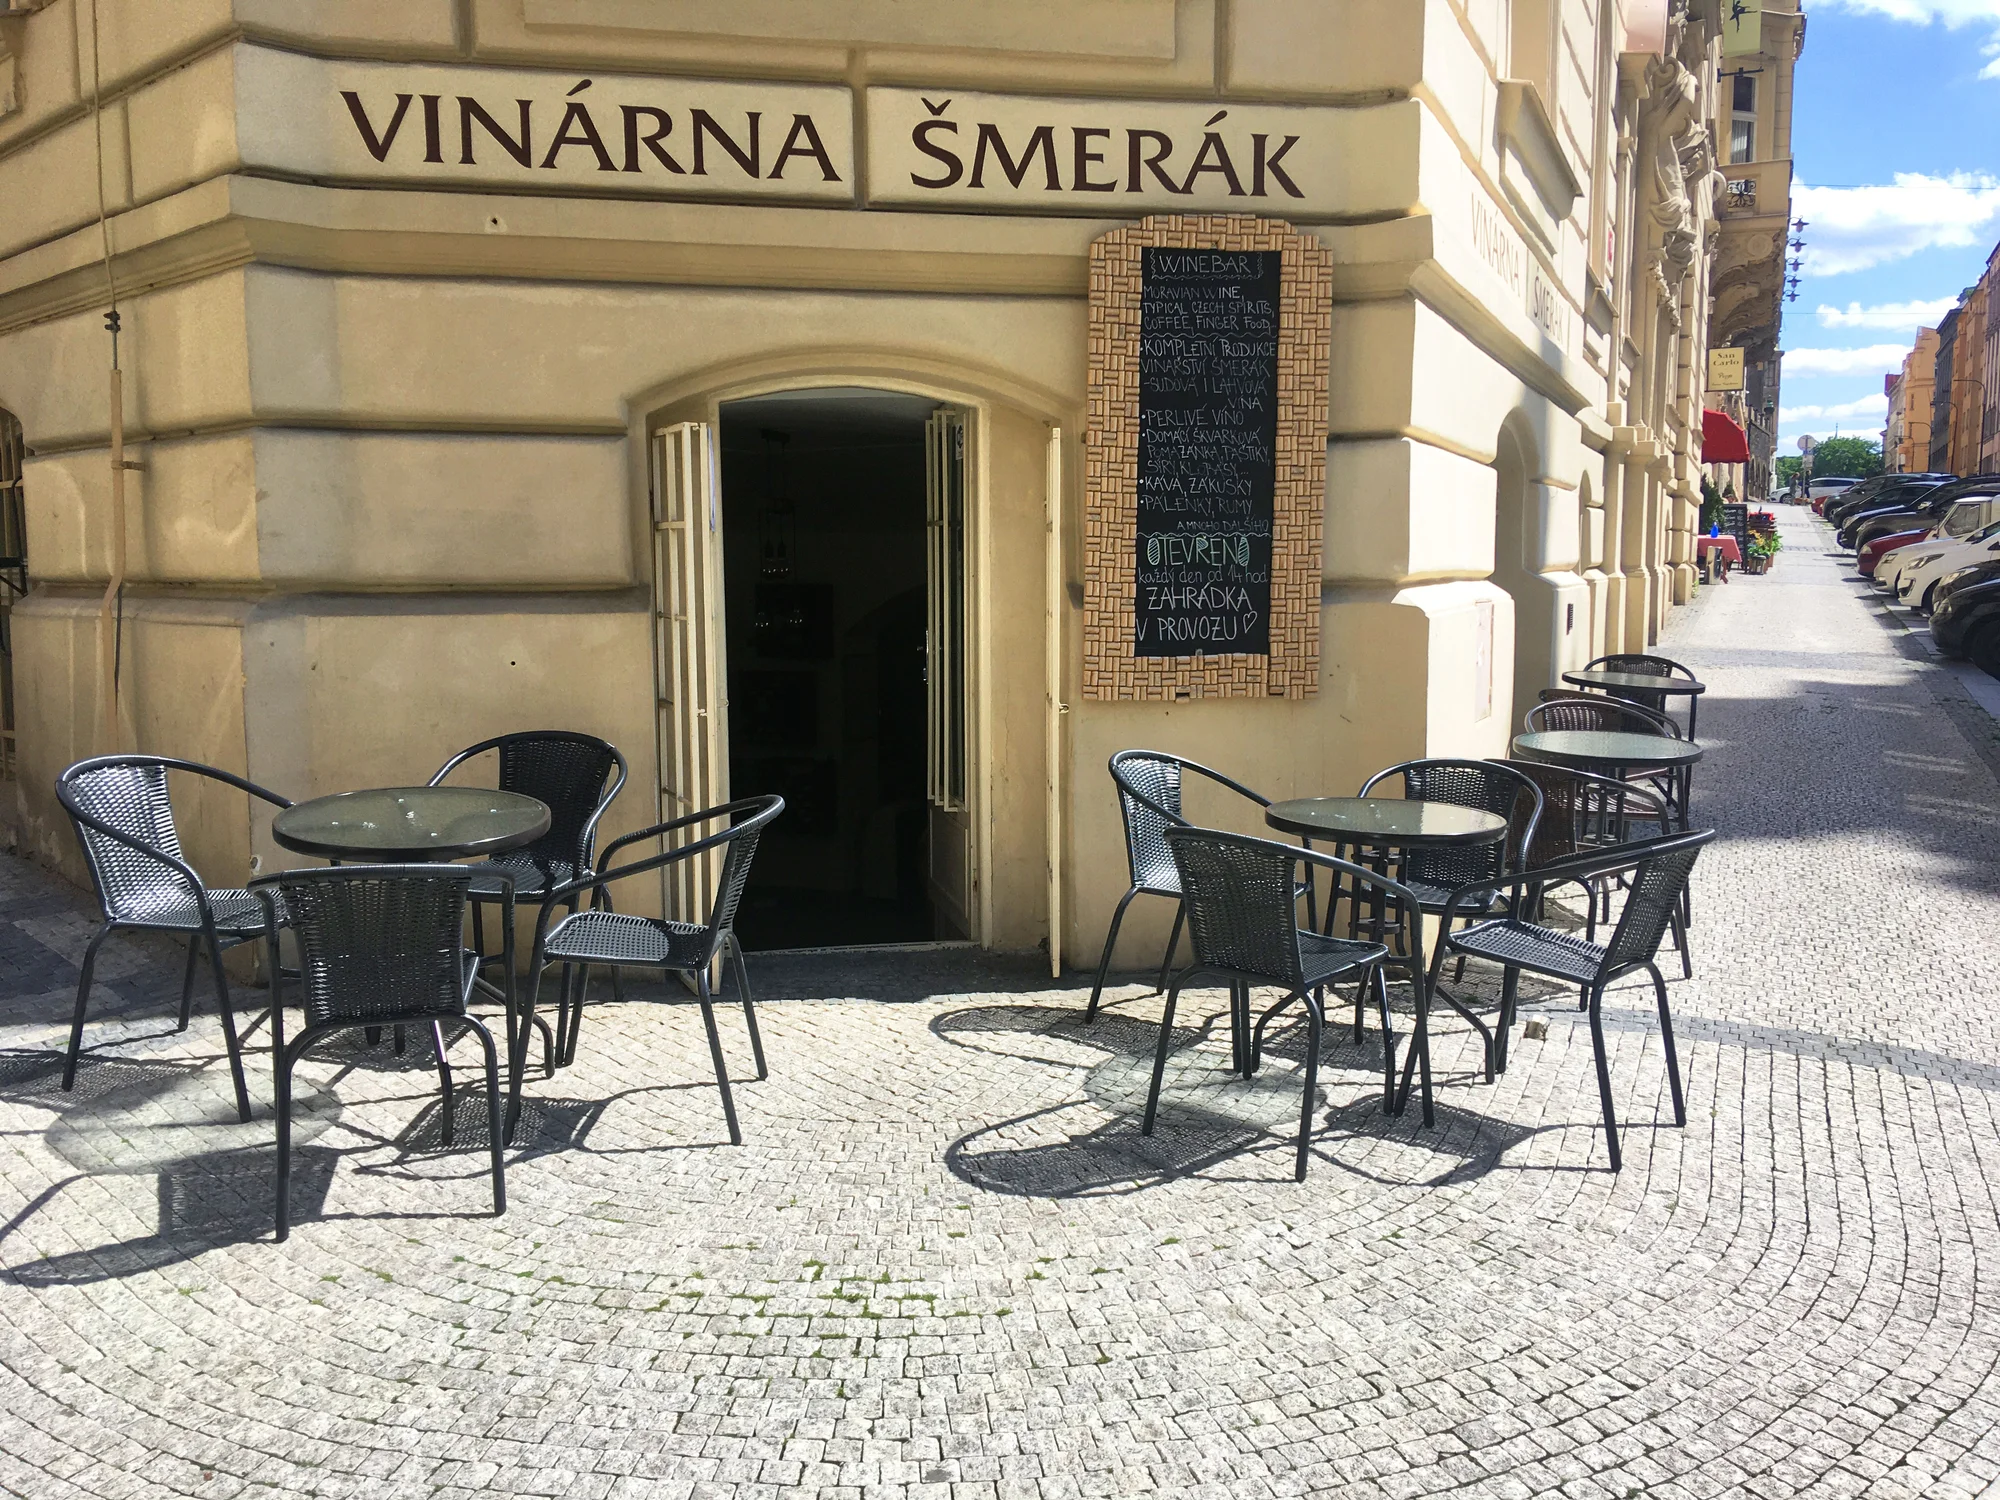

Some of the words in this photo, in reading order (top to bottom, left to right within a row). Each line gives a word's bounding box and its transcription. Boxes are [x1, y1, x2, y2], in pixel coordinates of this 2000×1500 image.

[340, 78, 843, 182] VINÁRNA
[909, 97, 1306, 199] ŠMERÁK
[1471, 192, 1520, 298] VINÁRNA
[1143, 285, 1200, 300] MORAVIAN
[1202, 286, 1245, 302] WINE,
[1142, 302, 1188, 316] TYPICAL
[1191, 301, 1224, 315] CZECH
[1228, 301, 1275, 318] SPIRITS,
[1196, 315, 1239, 331] FINGER
[1211, 356, 1271, 378] ŠMERÁK
[1227, 395, 1264, 412] VÍNA
[1145, 403, 1208, 427] PERLIVÉ
[1212, 405, 1244, 426] VÍNO
[1146, 427, 1190, 444] DOMÁCÍ
[1193, 426, 1262, 446] ŠKVARKOVÁ
[1188, 475, 1252, 496] ZÁKUSKY
[1216, 497, 1253, 515] RUMY
[1222, 515, 1269, 532] DALŠÍHO
[1147, 535, 1250, 567] OTEVŘENO
[1138, 566, 1175, 587] každý
[1179, 565, 1202, 584] den
[1207, 566, 1224, 584] od
[1227, 564, 1242, 583] 14
[1245, 564, 1269, 584] hod
[1146, 581, 1253, 612] ZAHRÁDKA
[1136, 617, 1149, 641] V
[1157, 615, 1238, 641] PROVOZU
